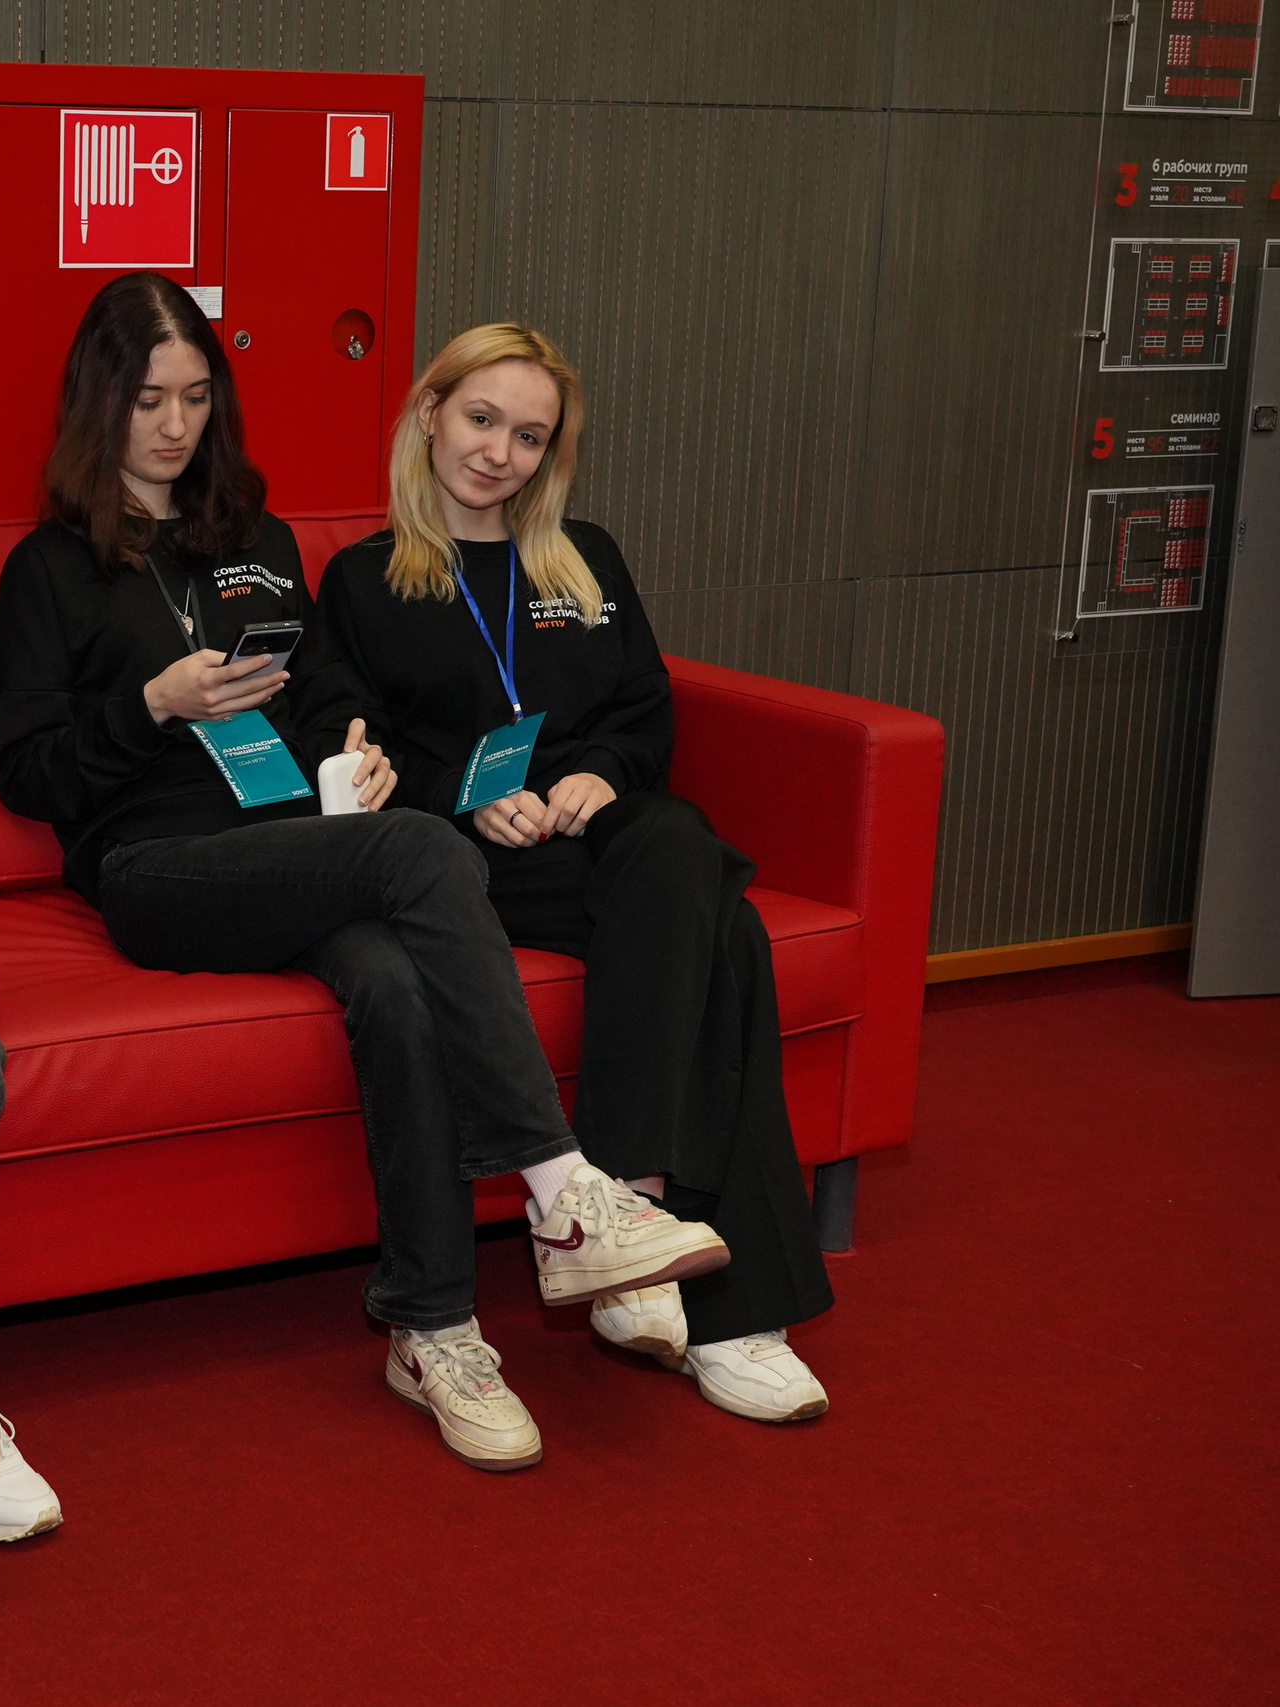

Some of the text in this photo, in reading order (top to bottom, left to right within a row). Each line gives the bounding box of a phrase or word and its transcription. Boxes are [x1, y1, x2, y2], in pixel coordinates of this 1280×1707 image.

[1152, 158, 1249, 178] 6 рабочих групп
[1114, 163, 1139, 207] 3
[1150, 185, 1170, 193] места
[1200, 195, 1226, 203] столами
[1170, 412, 1221, 426] семинар
[1091, 418, 1115, 460] 5
[1168, 435, 1187, 443] места
[1175, 443, 1201, 452] столами
[213, 564, 293, 589] СОВЕТ СТУДЕНТОВ
[216, 579, 227, 589] И
[221, 586, 252, 599] МГПУ
[531, 612, 541, 620] И
[535, 620, 566, 629] МГПУ
[222, 738, 282, 754] АНАСТАСИЯ
[191, 725, 245, 801] ОРГАНИЗАТОР
[461, 735, 488, 806] ОРГАНИЗАТОР
